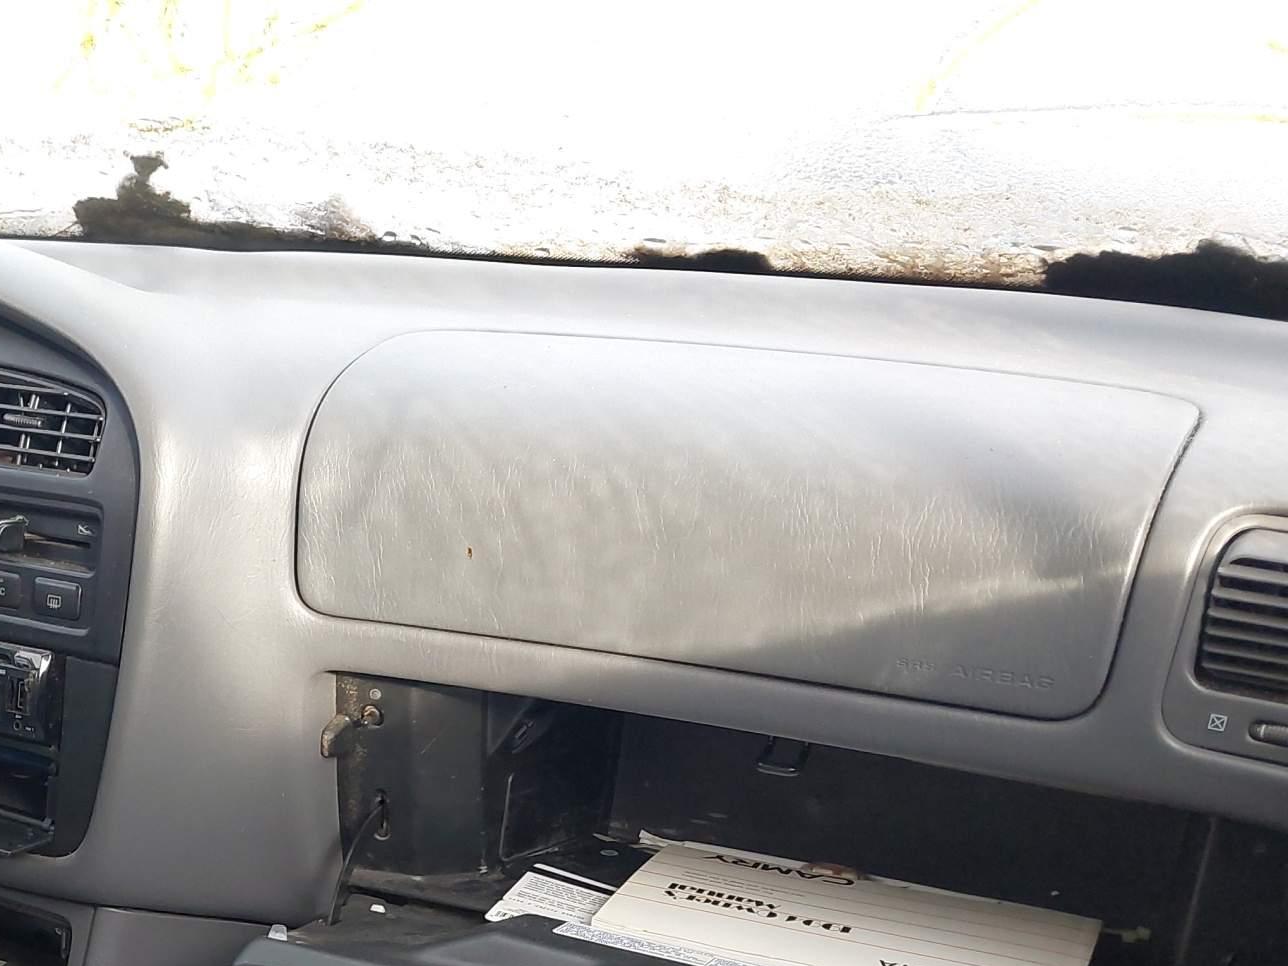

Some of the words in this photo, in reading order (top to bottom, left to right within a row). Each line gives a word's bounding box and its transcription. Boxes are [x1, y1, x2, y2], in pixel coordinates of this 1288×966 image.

[950, 664, 1056, 690] AIRBAG
[703, 855, 855, 886] CAMRY
[668, 882, 782, 910] Manual
